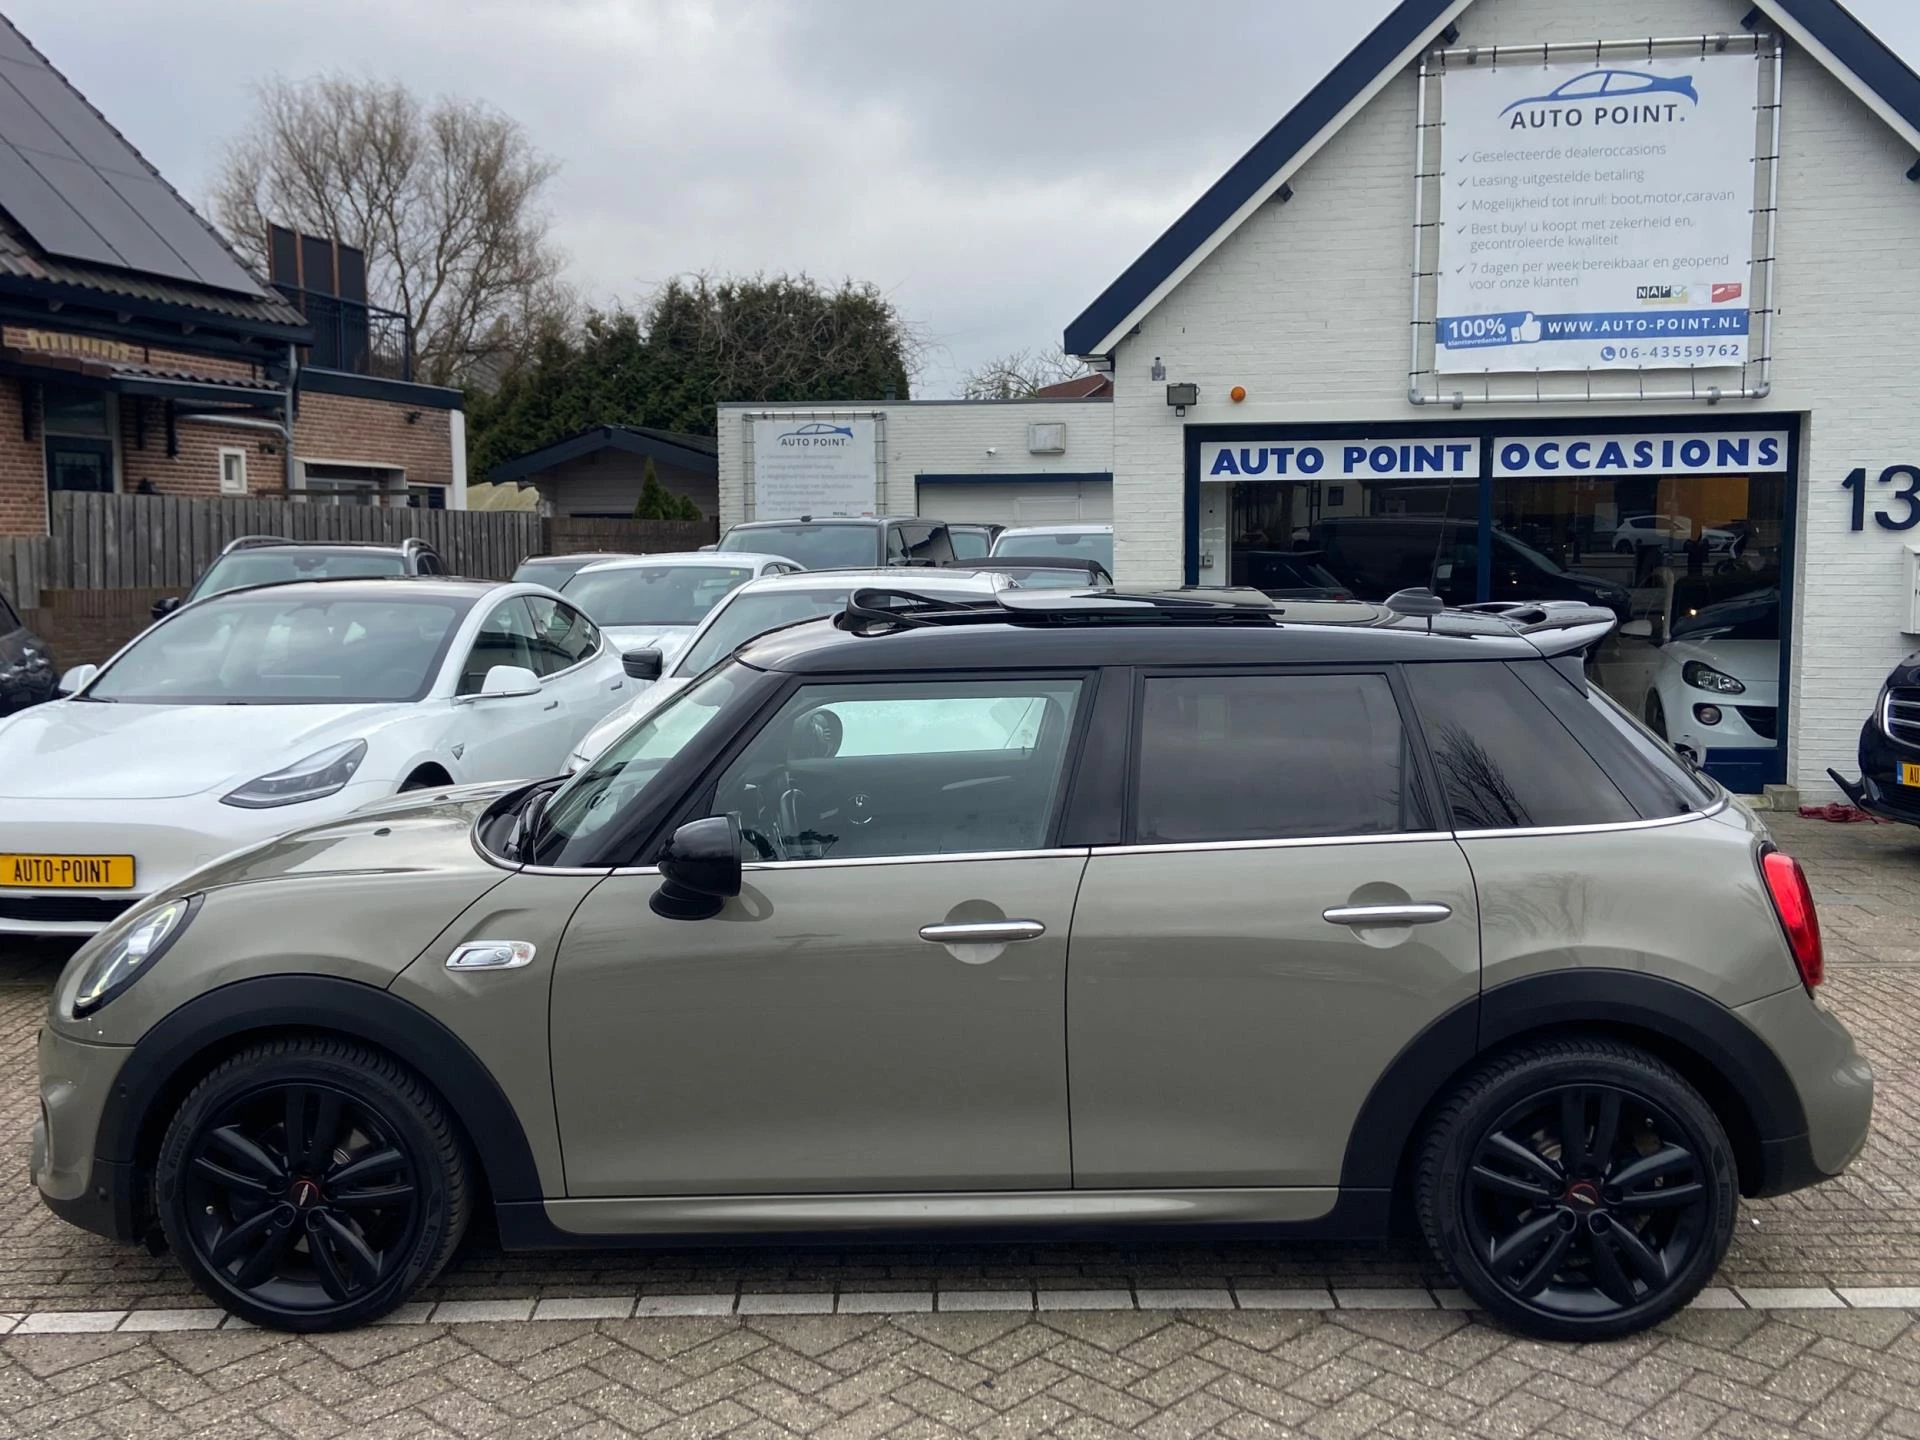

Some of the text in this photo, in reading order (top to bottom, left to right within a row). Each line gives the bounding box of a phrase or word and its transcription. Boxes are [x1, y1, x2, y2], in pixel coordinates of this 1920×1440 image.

[1510, 107, 1582, 130] AUTO
[1472, 144, 1666, 163] Geselecteerde dealeroccasions
[1594, 168, 1645, 183] betaling
[1472, 195, 1549, 213] Mogelijkheid
[1552, 197, 1569, 208] tot
[1471, 222, 1497, 235] Best
[1501, 221, 1527, 236] buy!
[1530, 224, 1539, 233] u
[1542, 220, 1577, 233] koopt
[1581, 219, 1606, 231] met
[1609, 215, 1671, 230] zekerheid
[1470, 234, 1618, 254] gecontroleerde kwaliteit
[1470, 254, 1729, 277] 7 dagen per week bereikbaar en geopend
[1469, 276, 1579, 291] voor onze klanten
[1637, 285, 1672, 299] NAP
[1448, 317, 1506, 339] 100%
[1547, 316, 1741, 334] WWW.AUTO-POINT.NL
[1618, 344, 1739, 359] 06-43559762
[781, 438, 810, 447] AUTO
[1209, 443, 1472, 476] AUTO POINT
[1500, 437, 1779, 471] OCCASIONS
[1841, 463, 1920, 532] 13
[14, 858, 111, 883] AUTO-POINT
